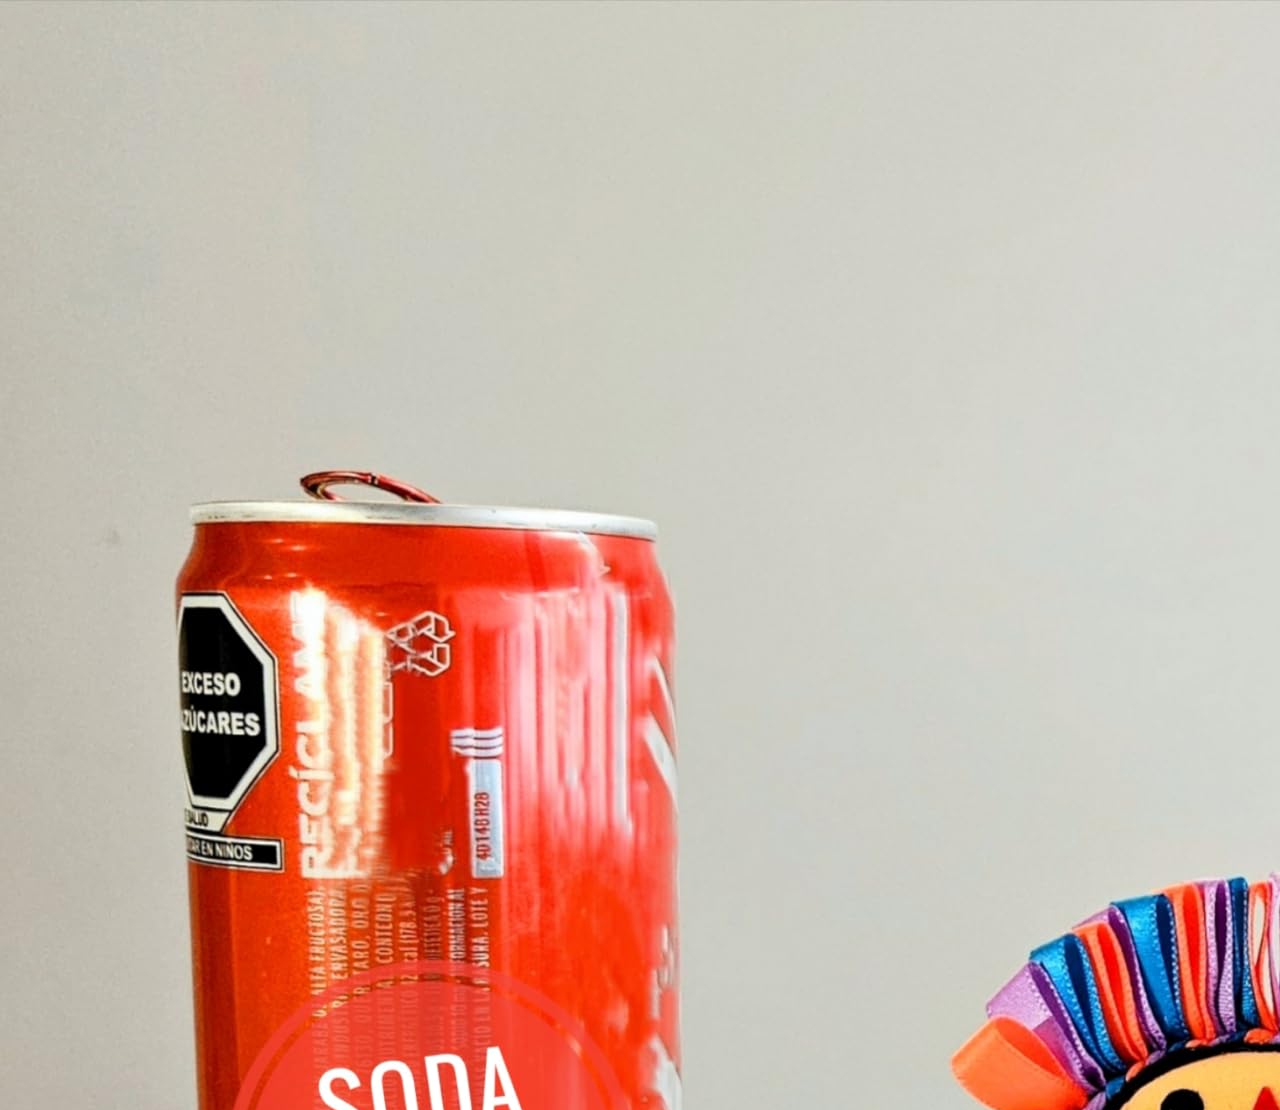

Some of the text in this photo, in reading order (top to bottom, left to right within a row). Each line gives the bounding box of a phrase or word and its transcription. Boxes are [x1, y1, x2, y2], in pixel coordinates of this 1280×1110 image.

[181, 671, 241, 697] EXCESO
[181, 704, 261, 736] ZÚCARES
[215, 838, 253, 861] NIÑOS
[469, 898, 489, 928] LOTE
